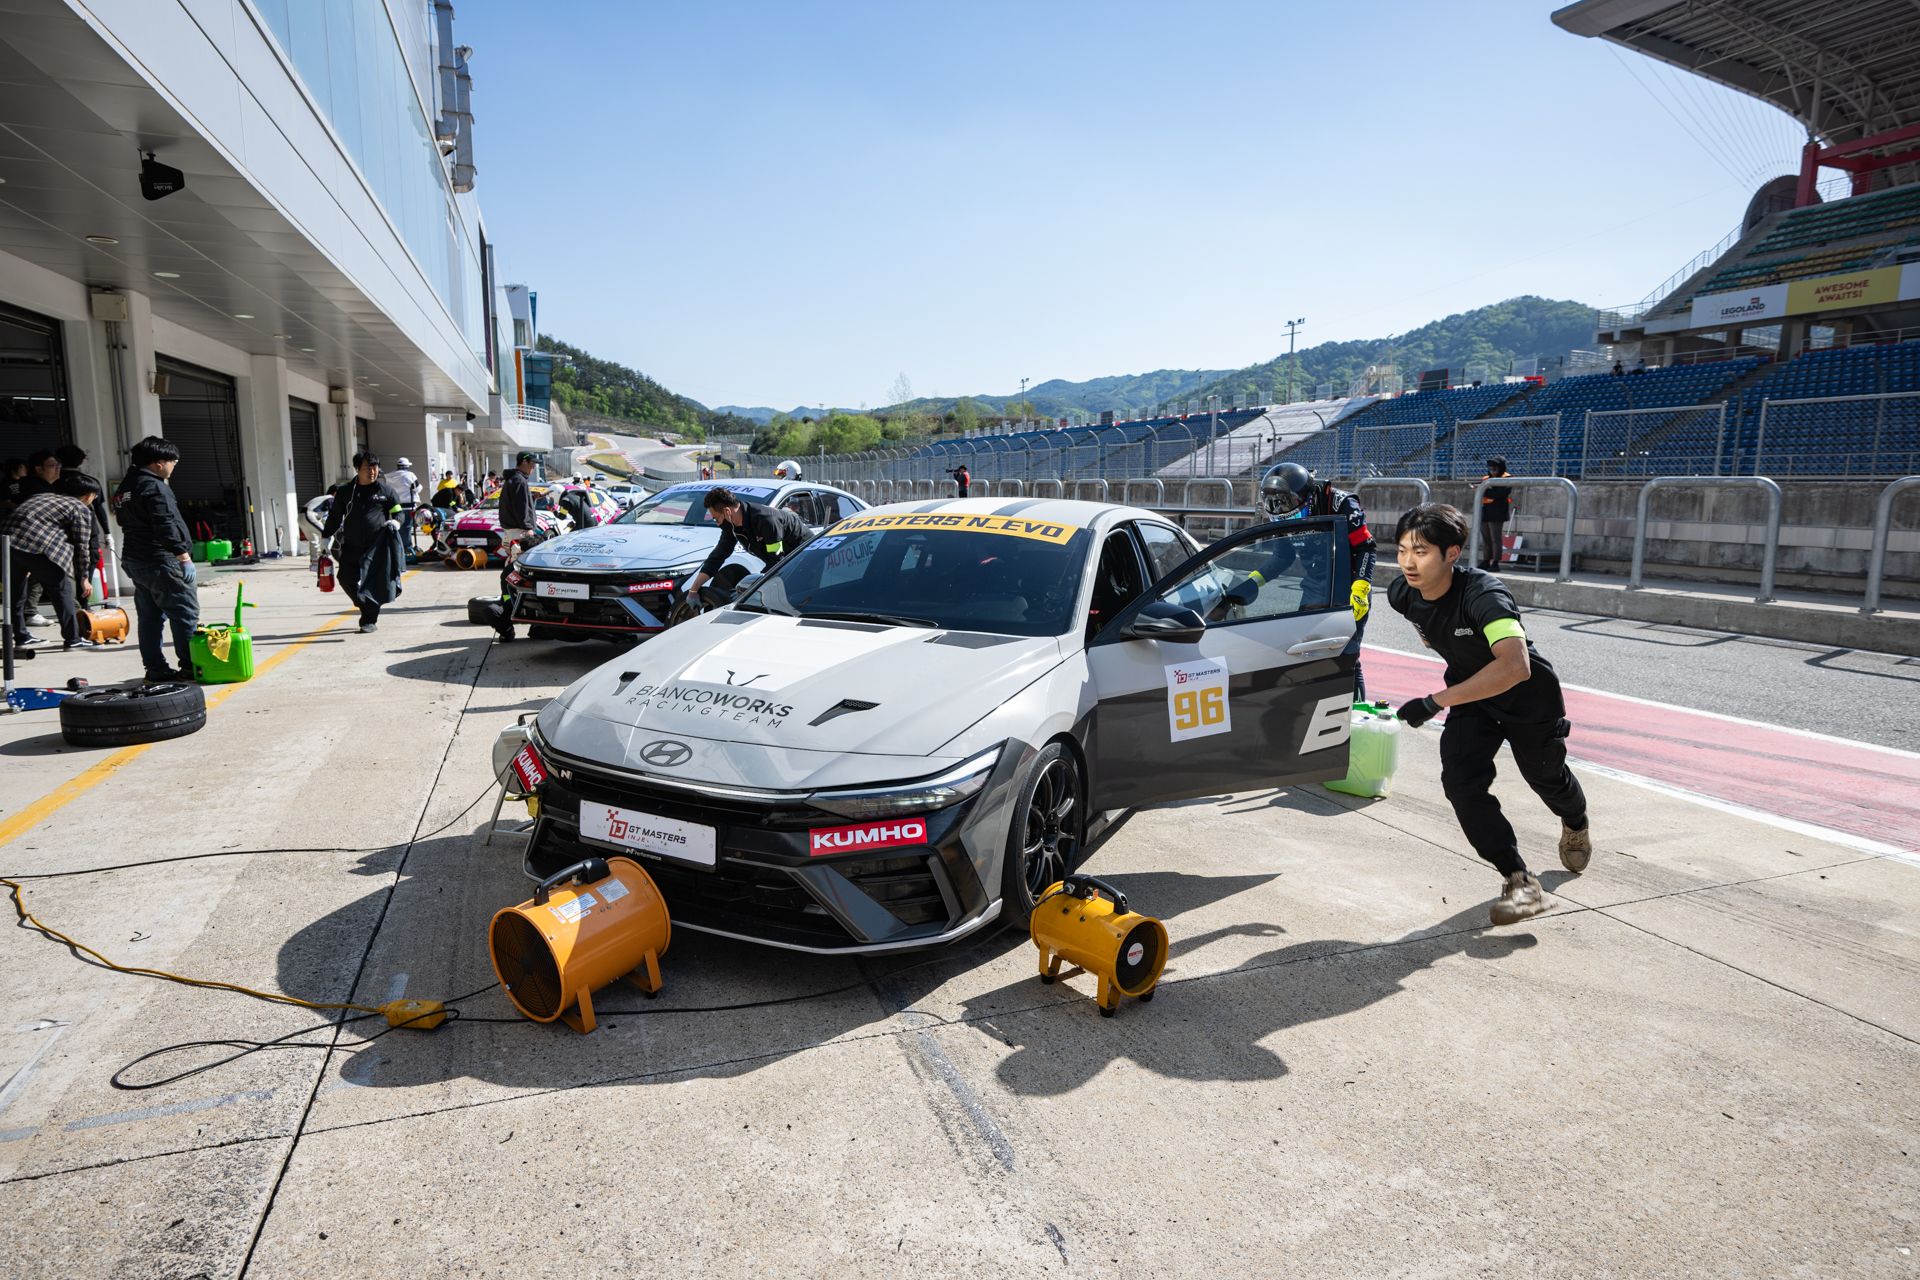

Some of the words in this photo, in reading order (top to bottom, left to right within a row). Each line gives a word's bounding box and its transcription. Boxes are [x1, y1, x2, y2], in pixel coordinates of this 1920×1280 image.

[1814, 279, 1870, 295] AWESOME
[1818, 290, 1863, 304] AWAITS!
[1721, 303, 1765, 315] LEGOLAND
[837, 515, 965, 532] MASTERS
[966, 517, 1066, 539] N_EVO
[803, 536, 848, 551] 96
[630, 581, 672, 591] KUMHO
[1195, 668, 1221, 677] MASTERS
[635, 685, 795, 718] BIANCOWORKS
[1173, 686, 1225, 731] 96
[517, 748, 542, 786] KUMHO
[629, 825, 641, 834] GT
[642, 828, 686, 844] MASTERS
[813, 823, 923, 849] KUMHO
